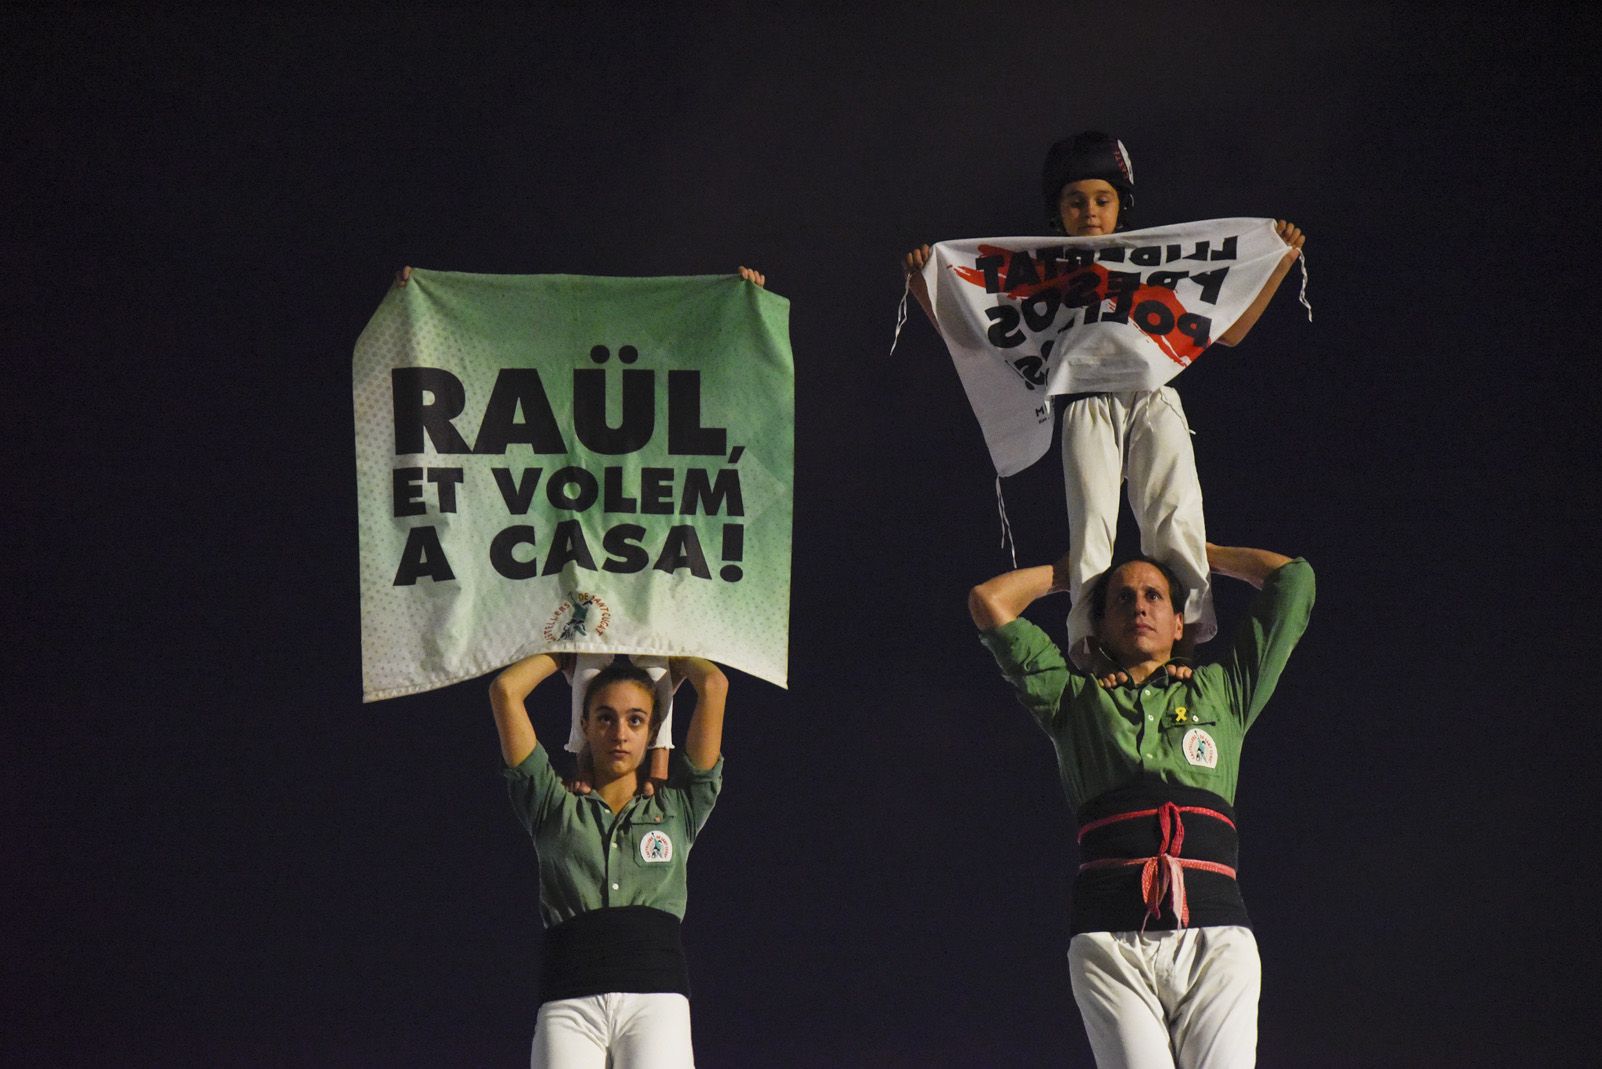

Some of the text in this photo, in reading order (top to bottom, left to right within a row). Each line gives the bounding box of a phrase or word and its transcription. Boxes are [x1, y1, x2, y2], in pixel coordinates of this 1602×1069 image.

[392, 345, 746, 464] RAÜL,
[392, 466, 745, 518] ET VOLEM
[393, 519, 745, 586] A CASA!
